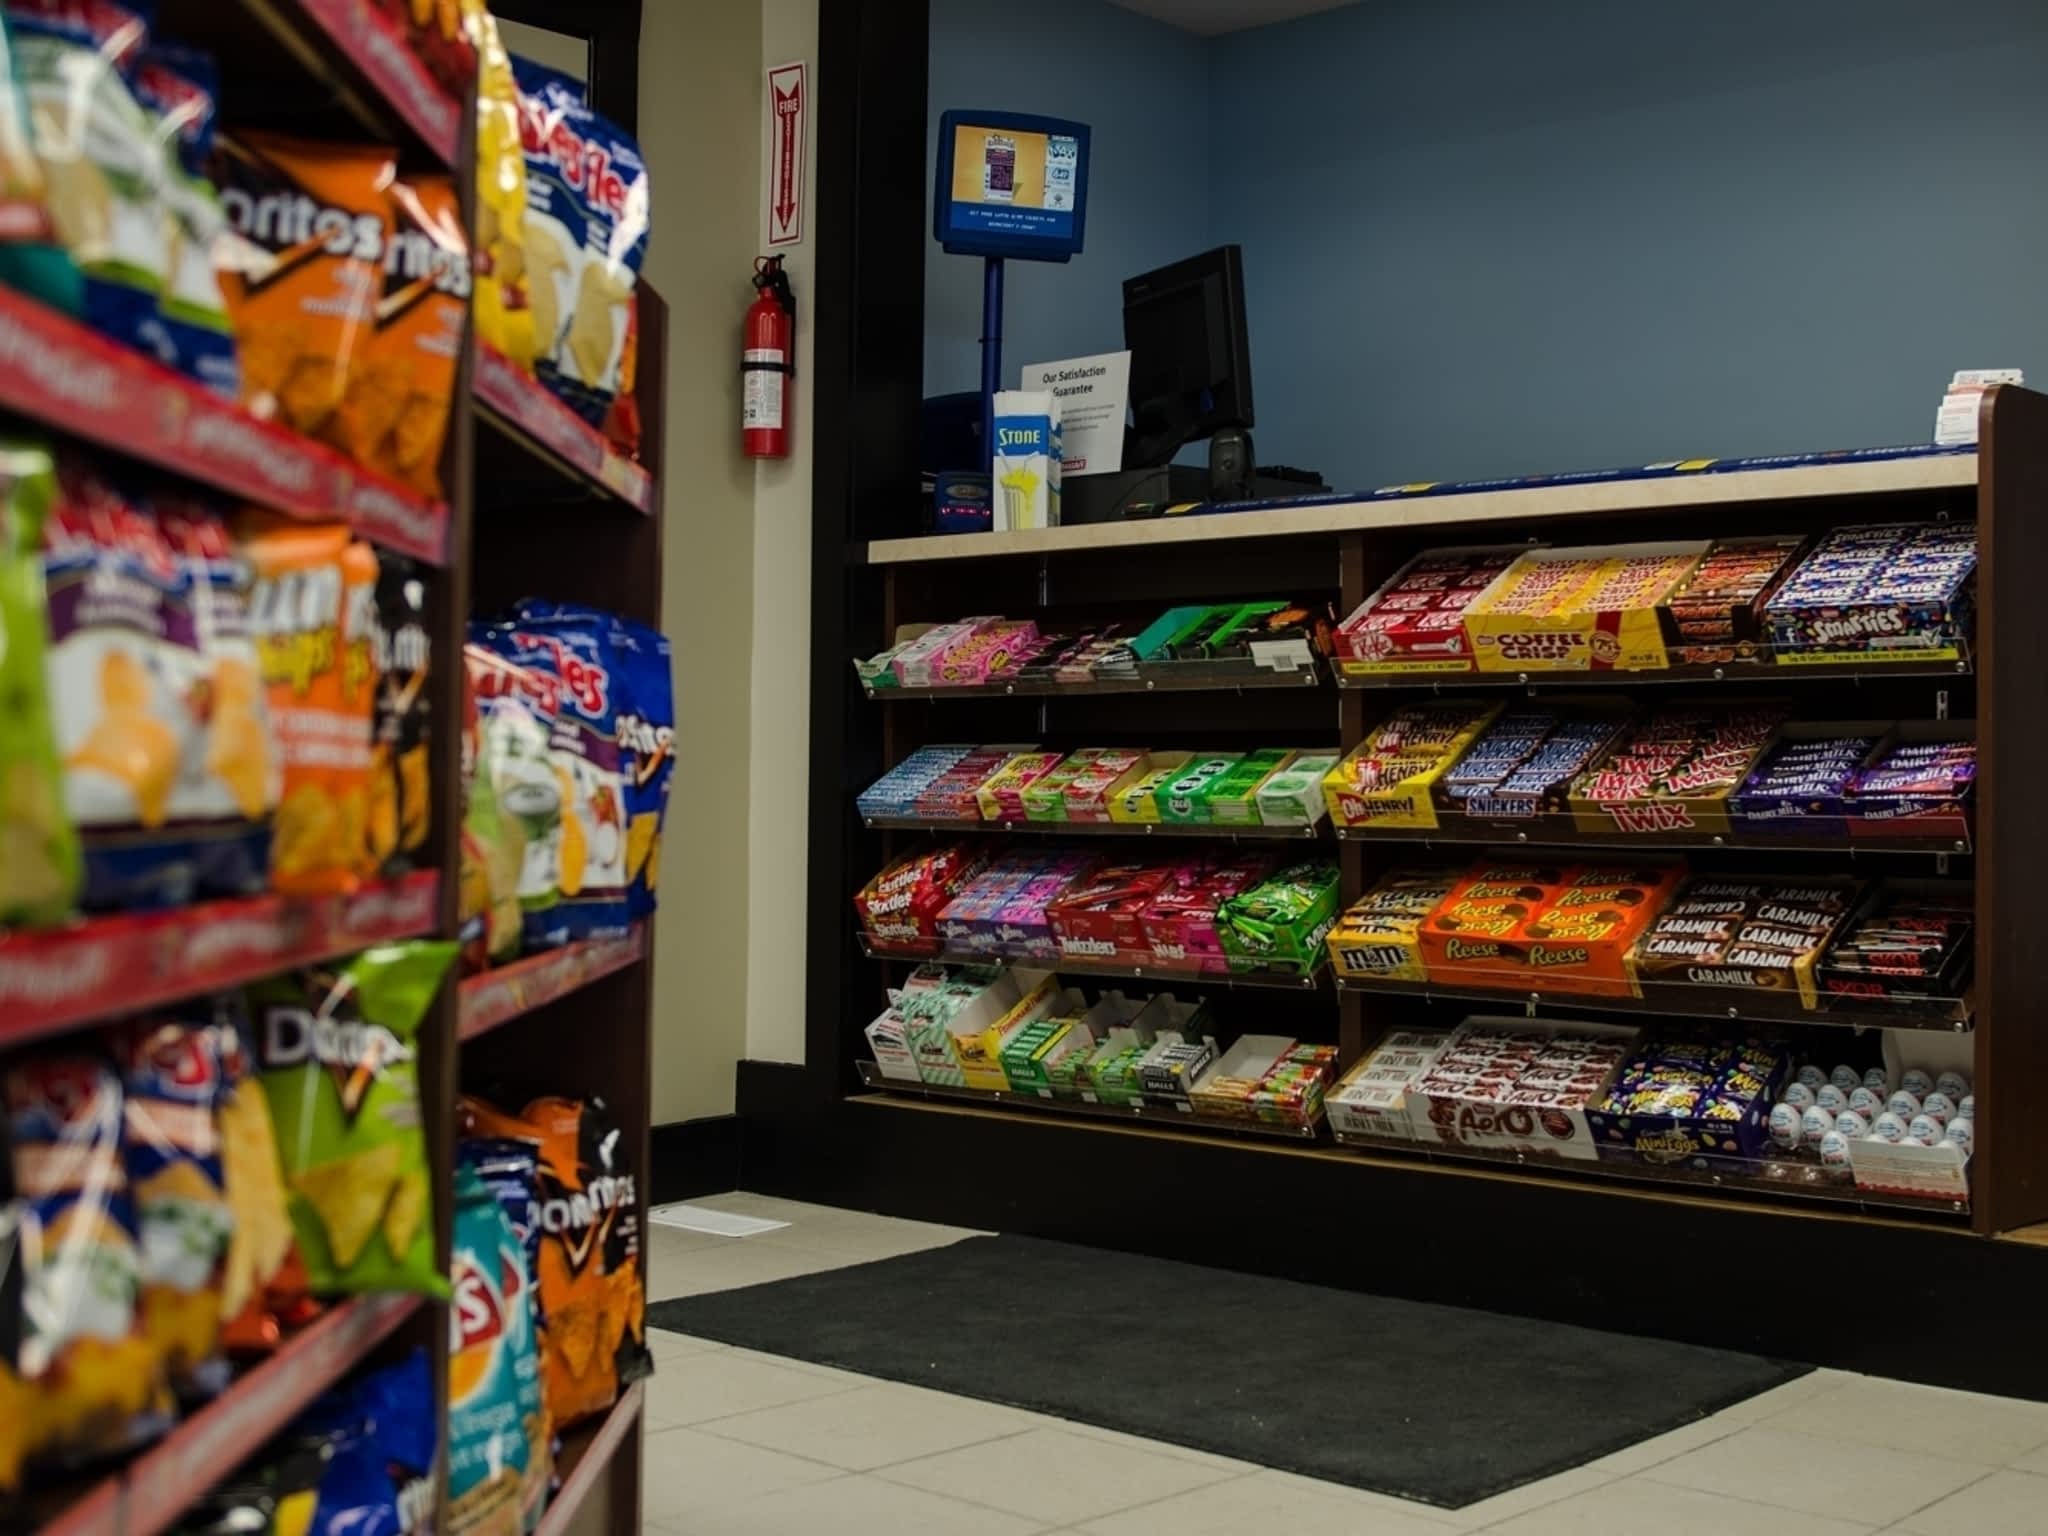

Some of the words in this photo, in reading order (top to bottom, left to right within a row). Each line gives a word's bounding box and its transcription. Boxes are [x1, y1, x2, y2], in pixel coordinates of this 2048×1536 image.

[778, 97, 799, 114] FIRE
[221, 187, 383, 260] oritos
[386, 228, 472, 298] ritos
[1042, 371, 1058, 385] Our
[1059, 365, 1107, 383] Satisfaction
[1052, 384, 1094, 398] Guarantee
[1497, 633, 1585, 646] COFFEE
[1501, 646, 1571, 660] CRISP
[1366, 796, 1418, 817] HENRY!
[1469, 799, 1535, 815] SNICKERS
[1461, 882, 1522, 900] Reese
[1556, 888, 1621, 908] Reese
[1756, 904, 1836, 929] CARAMILK
[1657, 919, 1729, 937] CARAMILK
[1738, 926, 1820, 949] CARAMILK
[1445, 936, 1500, 961] Reese
[1528, 944, 1589, 967] Reese
[1645, 938, 1722, 957] CARAMILK
[1867, 953, 1922, 967] SKOR
[1687, 967, 1757, 986] CARAMILK
[1826, 979, 1887, 999] SKOR
[1146, 1079, 1176, 1091] HALLS
